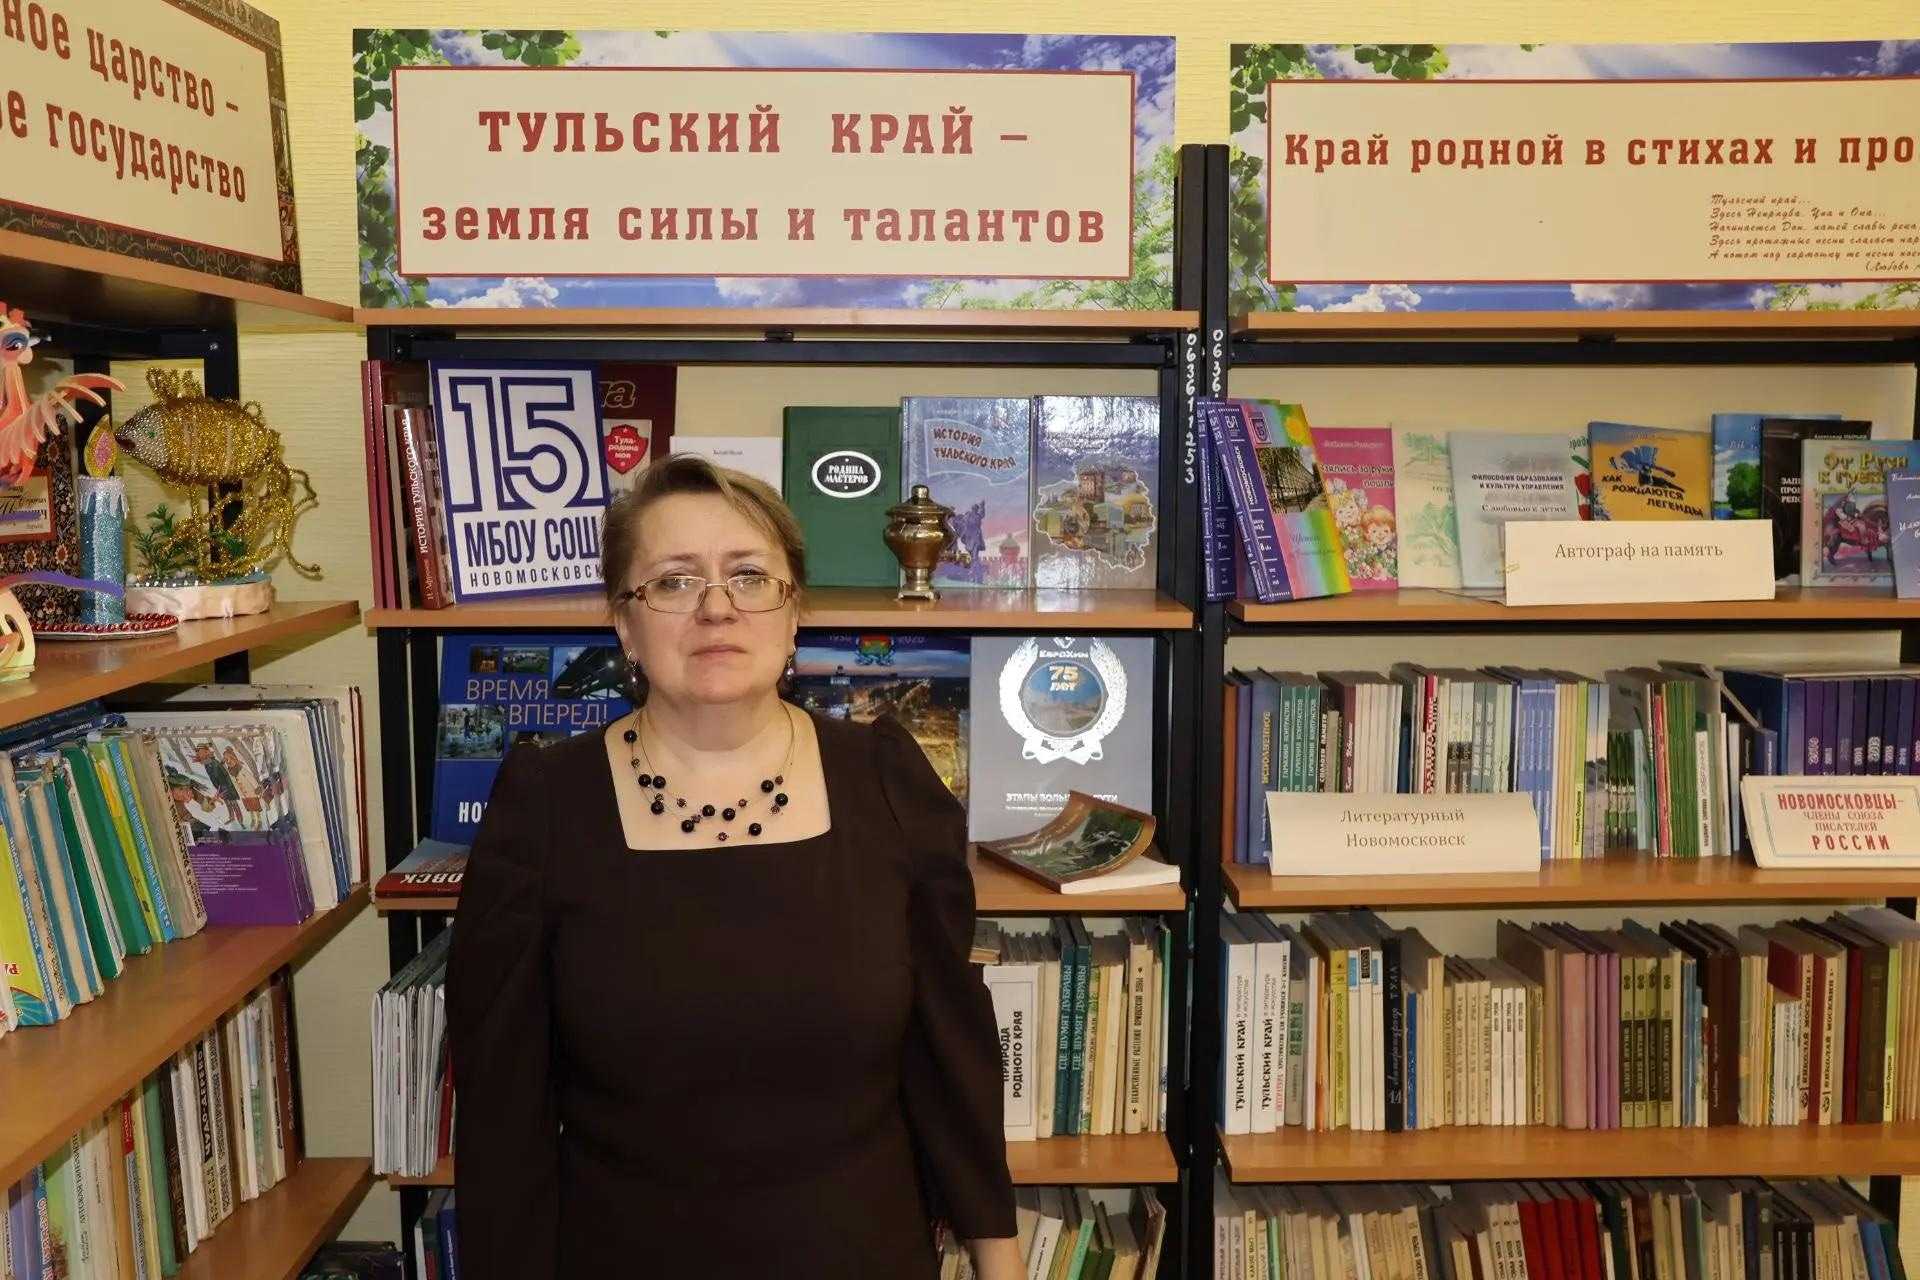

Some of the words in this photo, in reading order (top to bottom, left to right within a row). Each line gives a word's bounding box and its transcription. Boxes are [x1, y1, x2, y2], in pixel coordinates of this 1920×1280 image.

[86, 27, 216, 118] царство
[478, 104, 780, 153] ТУЛЬСКИЙ
[831, 106, 974, 154] КРАЙ
[0, 89, 28, 139] е
[46, 103, 246, 203] государство
[1285, 133, 1390, 173] Край
[1411, 133, 1564, 173] родной
[1585, 139, 1606, 165] в
[1627, 138, 1774, 165] стихах
[1794, 138, 1817, 164] и
[1839, 136, 1920, 171] про
[1711, 194, 1766, 206] Тульский
[422, 206, 590, 241] земля
[618, 207, 759, 241] силы
[787, 208, 815, 241] и
[844, 208, 1105, 242] талантов
[1900, 236, 1920, 246] нар
[608, 444, 640, 454] родина
[933, 428, 982, 448] ИСТОРИЯ
[828, 465, 864, 475] РОДИНА
[934, 447, 988, 468] ТУЛЬСКОГО
[990, 456, 1017, 470] КРАЯ
[405, 446, 426, 503] ТУЛЬСКОГО
[824, 474, 868, 485] МАСТЕРОВ
[1602, 474, 1623, 483] КАК
[1612, 485, 1684, 501] РОЖДАЮТСЯ
[1647, 498, 1704, 517] ЛЕГЕНДЫ
[412, 503, 429, 554] ИСТОРИЯ
[463, 519, 537, 568] МБОУ
[544, 515, 600, 561] СОШ
[1555, 543, 1635, 561] Автограф
[1641, 546, 1660, 557] на
[1664, 544, 1724, 557] память
[1050, 666, 1081, 681] 75
[1050, 682, 1077, 691] ЛЕТ
[466, 679, 549, 701] ВРЕМЯ
[509, 703, 608, 729] ВПЕРЕД!
[1006, 793, 1038, 802] ЭТАПЫ
[458, 802, 488, 823] НО
[1340, 809, 1465, 825] Литературный
[1803, 811, 1841, 820] ЧЛЕНЫ
[1847, 811, 1884, 820] СОЮЗА
[1815, 820, 1878, 832] ПИСАТЕЛЕЙ
[1346, 833, 1466, 848] Новомосковск
[1811, 834, 1890, 850] РОССИИ
[1062, 965, 1072, 1012] ДУБРАВЫ
[1076, 965, 1086, 1013] ДУБРАВЫ
[1390, 966, 1398, 1000] ТУЛА
[1804, 976, 1812, 1028] МОСКВИН
[1826, 978, 1834, 1031] МОСКВИН
[1013, 1011, 1023, 1042] КРАЯ
[1060, 1014, 1070, 1049] ШУМЯТ
[1074, 1015, 1084, 1050] ШУМЯТ
[1236, 1020, 1246, 1049] КРАЙ
[1262, 1018, 1273, 1048] КРАЙ
[1059, 1053, 1068, 1070] ГДЕ
[1072, 1053, 1081, 1070] ГДЕ
[1802, 1032, 1810, 1084] НИКОЛАЙ
[1823, 1035, 1832, 1088] НИКОЛАЙ
[1013, 1046, 1023, 1098] РОДНОГО
[1235, 1053, 1245, 1111] ТУЛЬСКИЙ
[1261, 1052, 1272, 1110] ТУЛЬСКИЙ
[197, 1046, 213, 1160] ЧУДО-ДЕРЕВО
